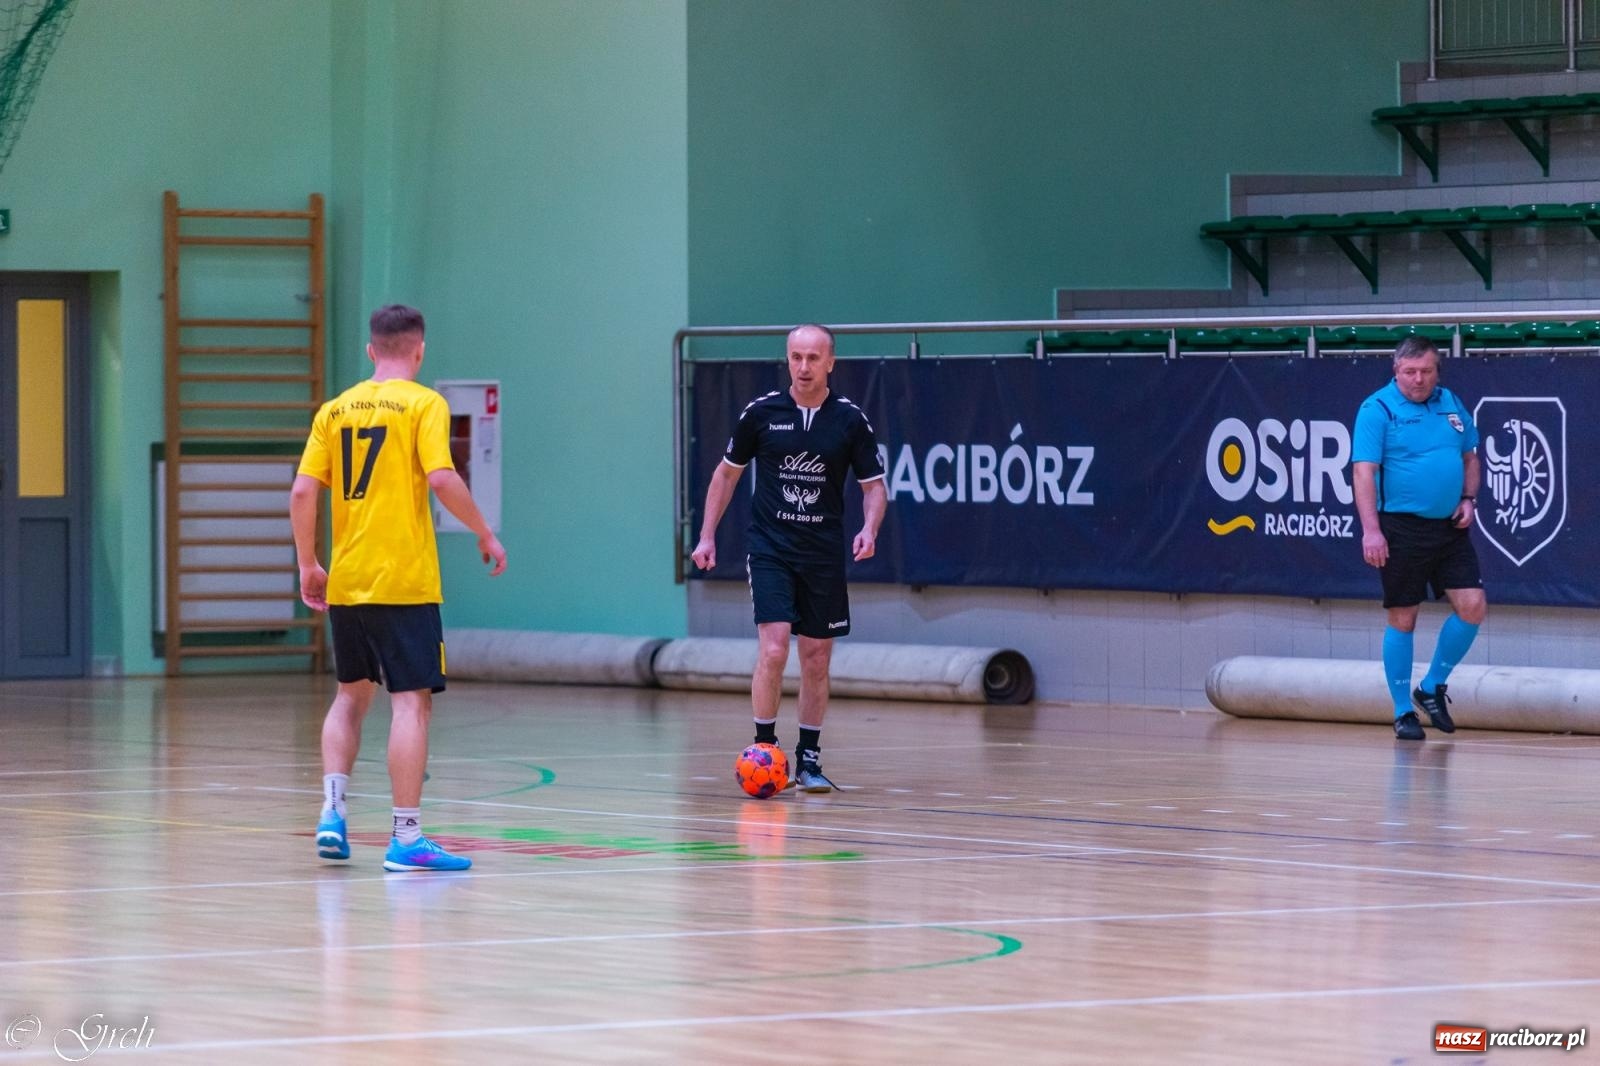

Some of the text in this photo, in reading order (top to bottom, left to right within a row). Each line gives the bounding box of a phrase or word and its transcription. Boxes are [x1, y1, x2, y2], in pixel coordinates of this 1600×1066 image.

[769, 423, 794, 431] hummel
[340, 425, 387, 501] 17
[779, 451, 826, 473] Ada
[779, 472, 797, 480] SALON
[782, 512, 795, 520] 514
[1264, 507, 1354, 538] RACIBÓRZ
